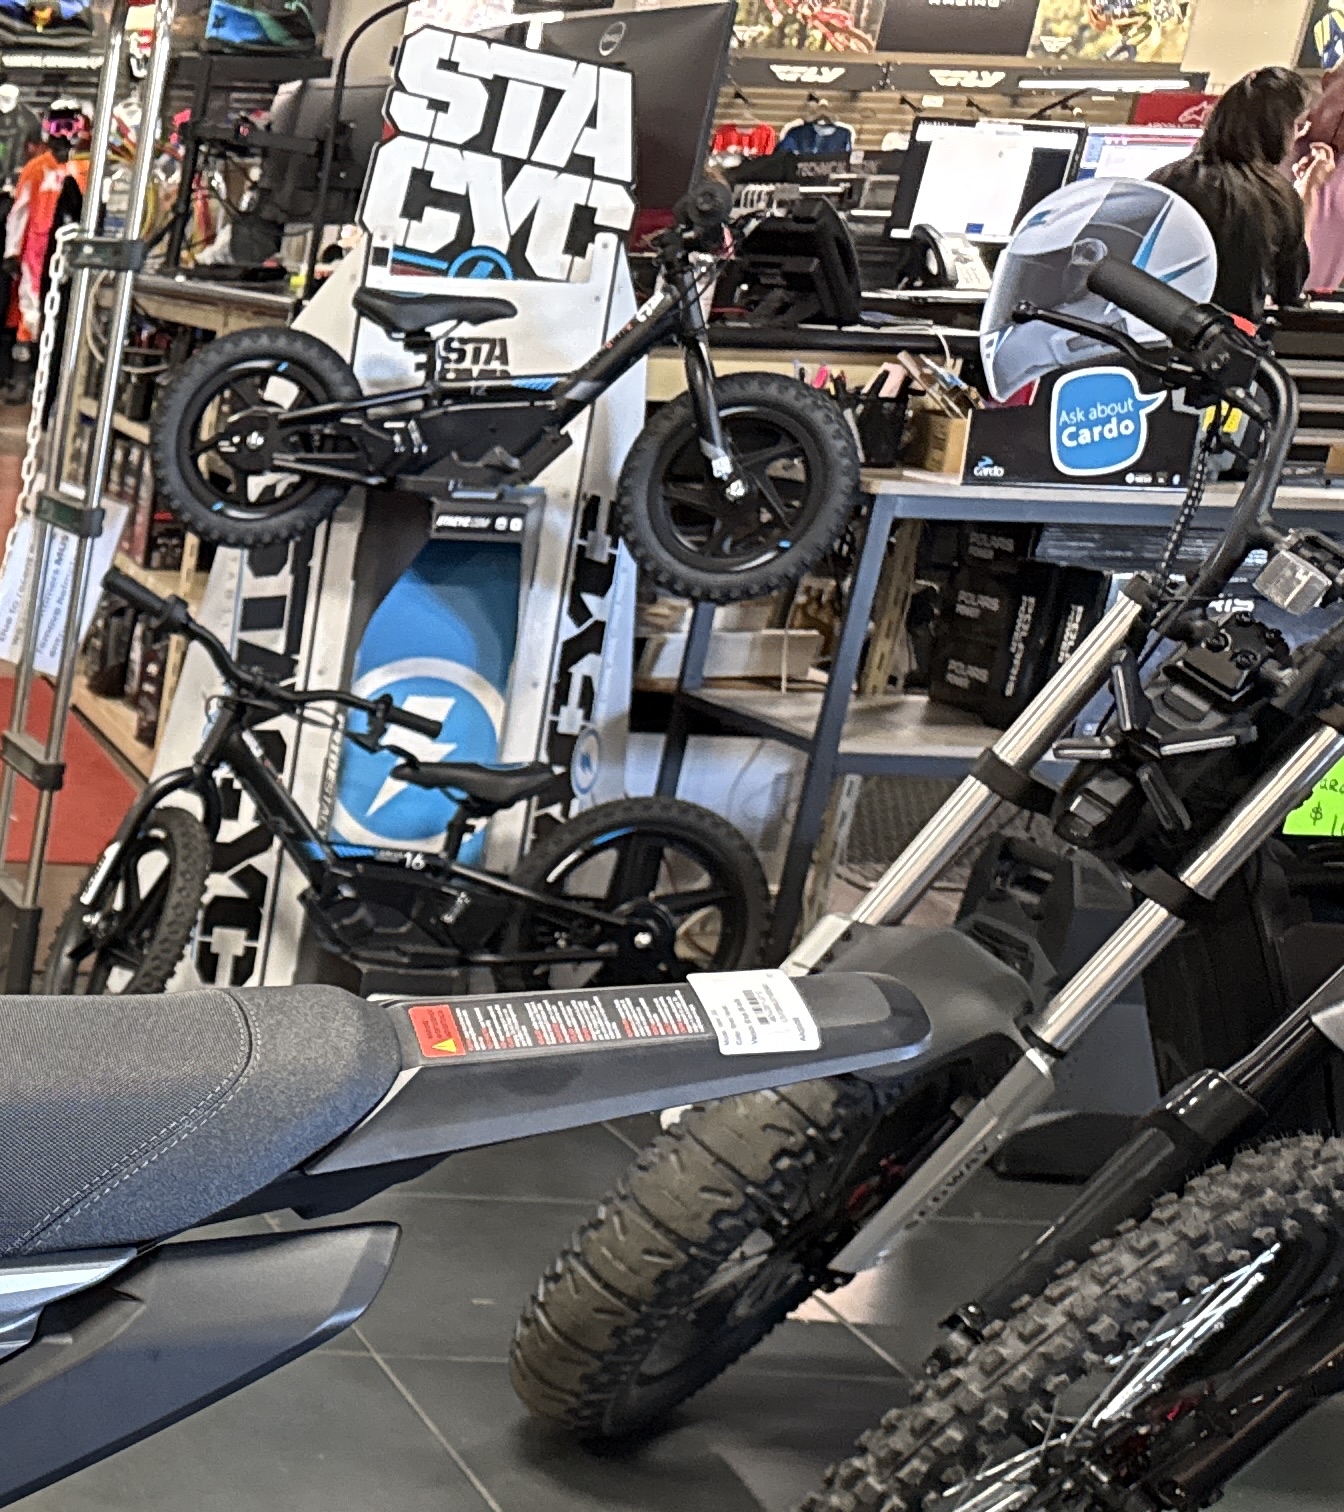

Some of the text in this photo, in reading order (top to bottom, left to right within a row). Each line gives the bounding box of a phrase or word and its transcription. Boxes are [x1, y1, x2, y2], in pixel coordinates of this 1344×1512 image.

[389, 29, 635, 184] STA
[361, 137, 636, 283] CYC
[1059, 397, 1135, 428] Ask about
[1061, 419, 1136, 450] Cardo
[403, 851, 426, 872] 16
